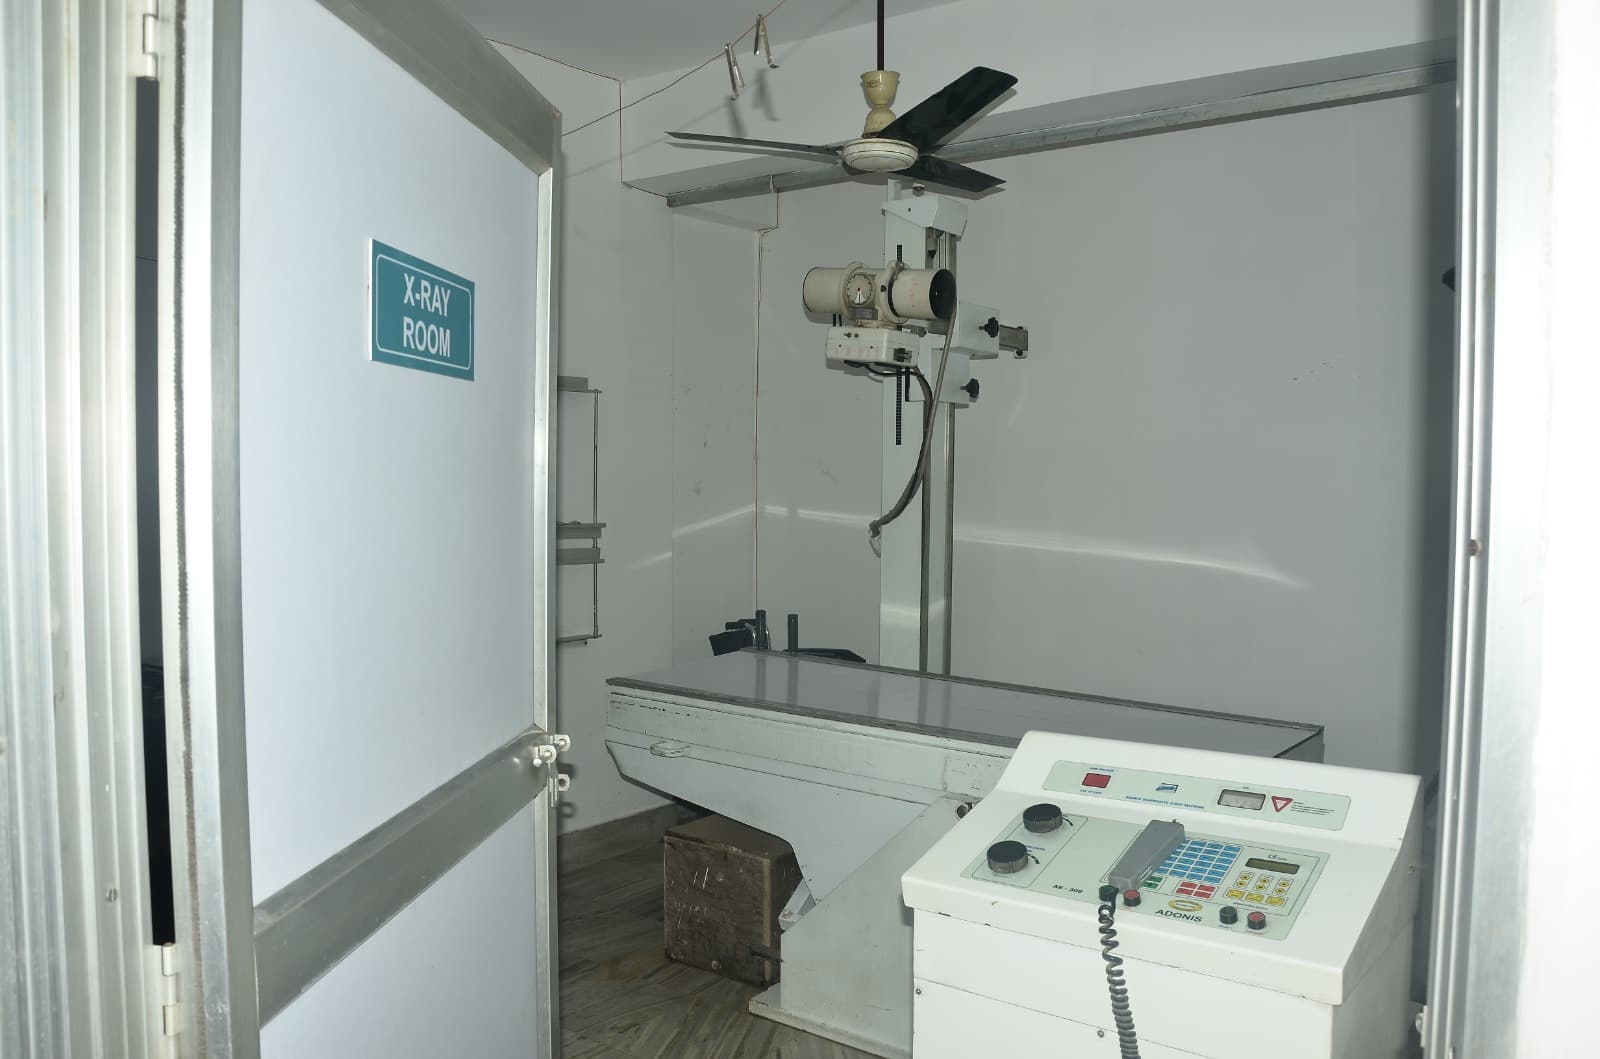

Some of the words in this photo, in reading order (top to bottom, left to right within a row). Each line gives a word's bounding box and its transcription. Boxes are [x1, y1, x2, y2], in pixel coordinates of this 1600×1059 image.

[403, 272, 451, 317] X-RAY
[403, 316, 451, 358] ROOM
[1155, 909, 1203, 922] ADONIS
